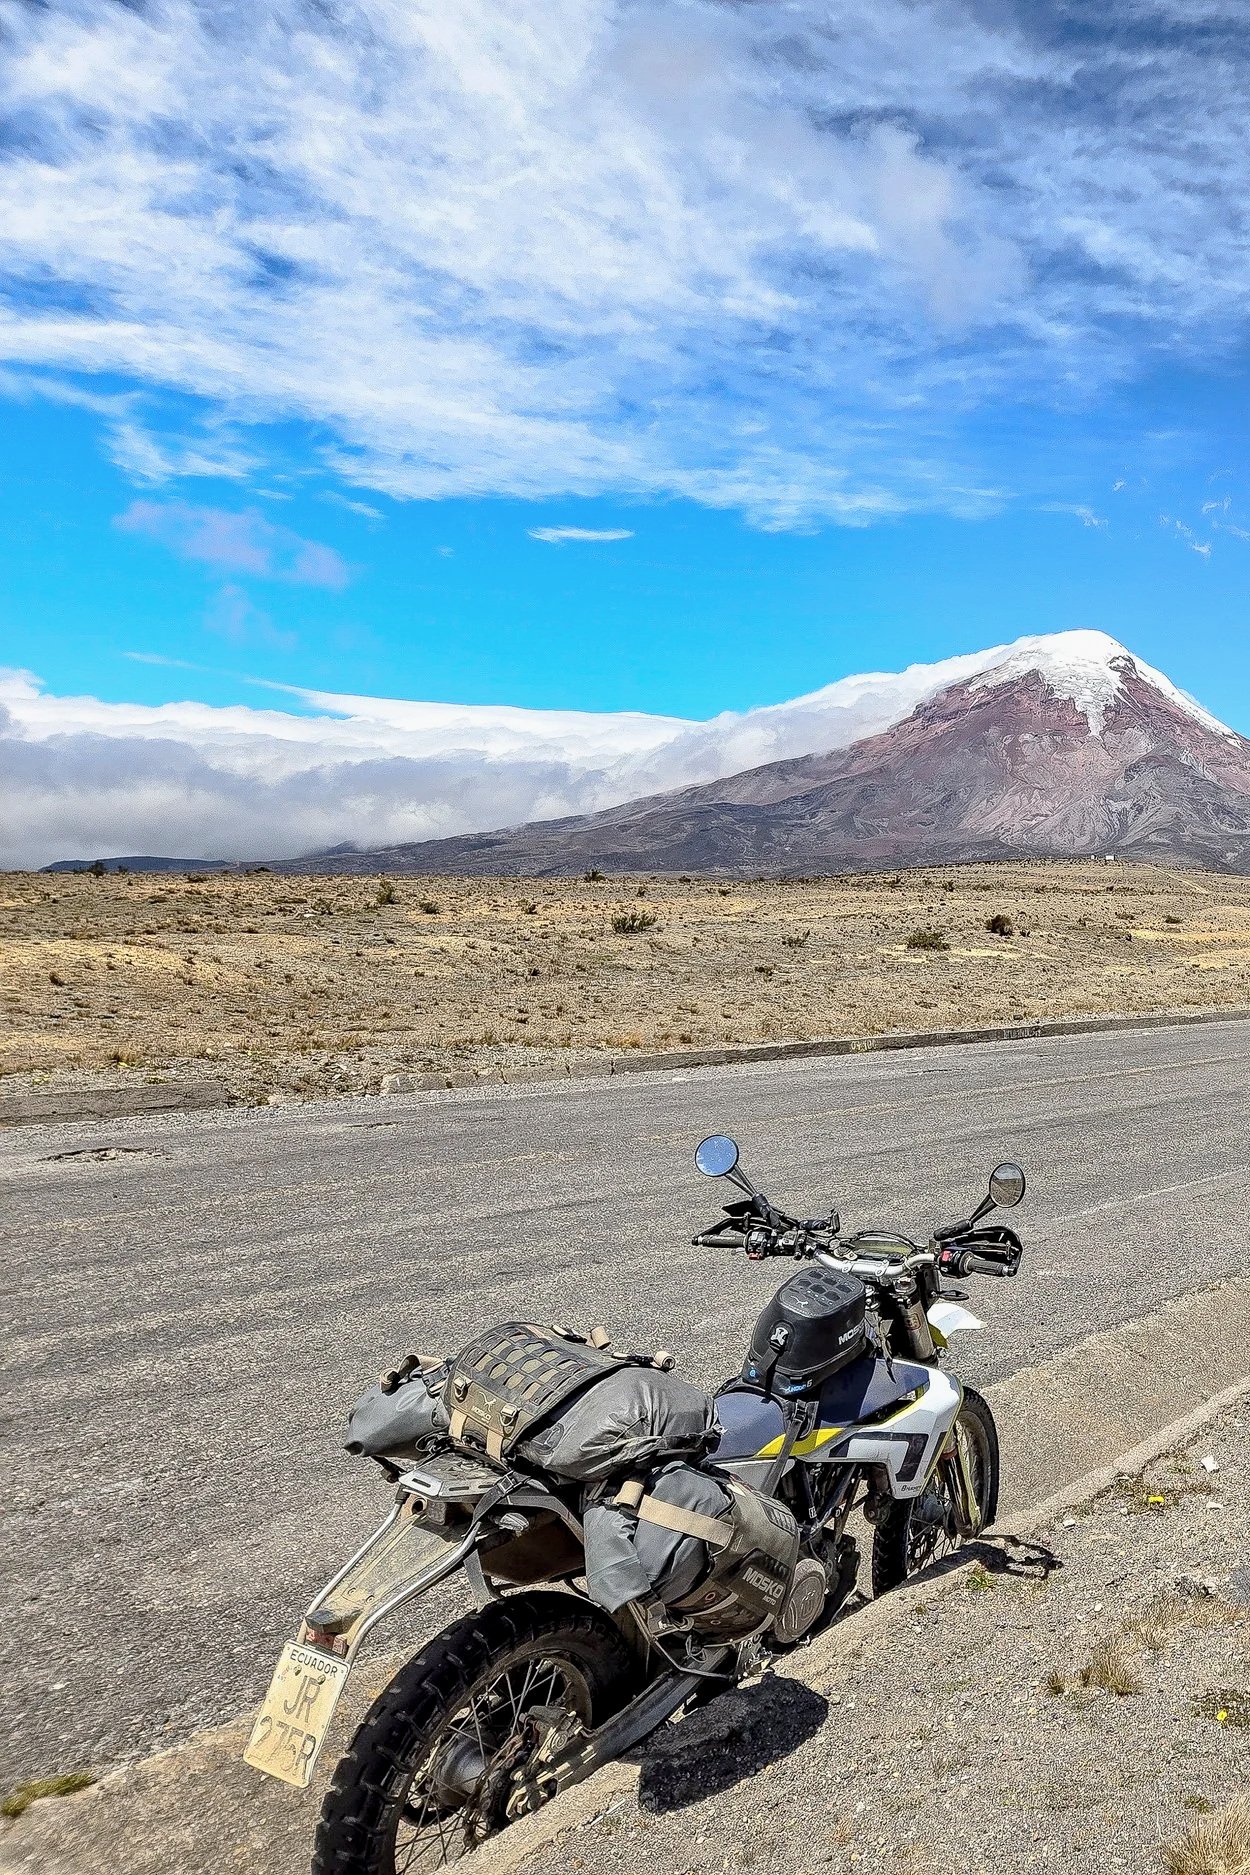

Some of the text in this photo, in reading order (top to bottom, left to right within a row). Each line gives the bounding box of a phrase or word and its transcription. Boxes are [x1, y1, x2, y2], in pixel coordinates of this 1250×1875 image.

[742, 1567, 784, 1599] MOSKO
[289, 1650, 338, 1678] ECUADOR
[284, 1674, 321, 1723] JR
